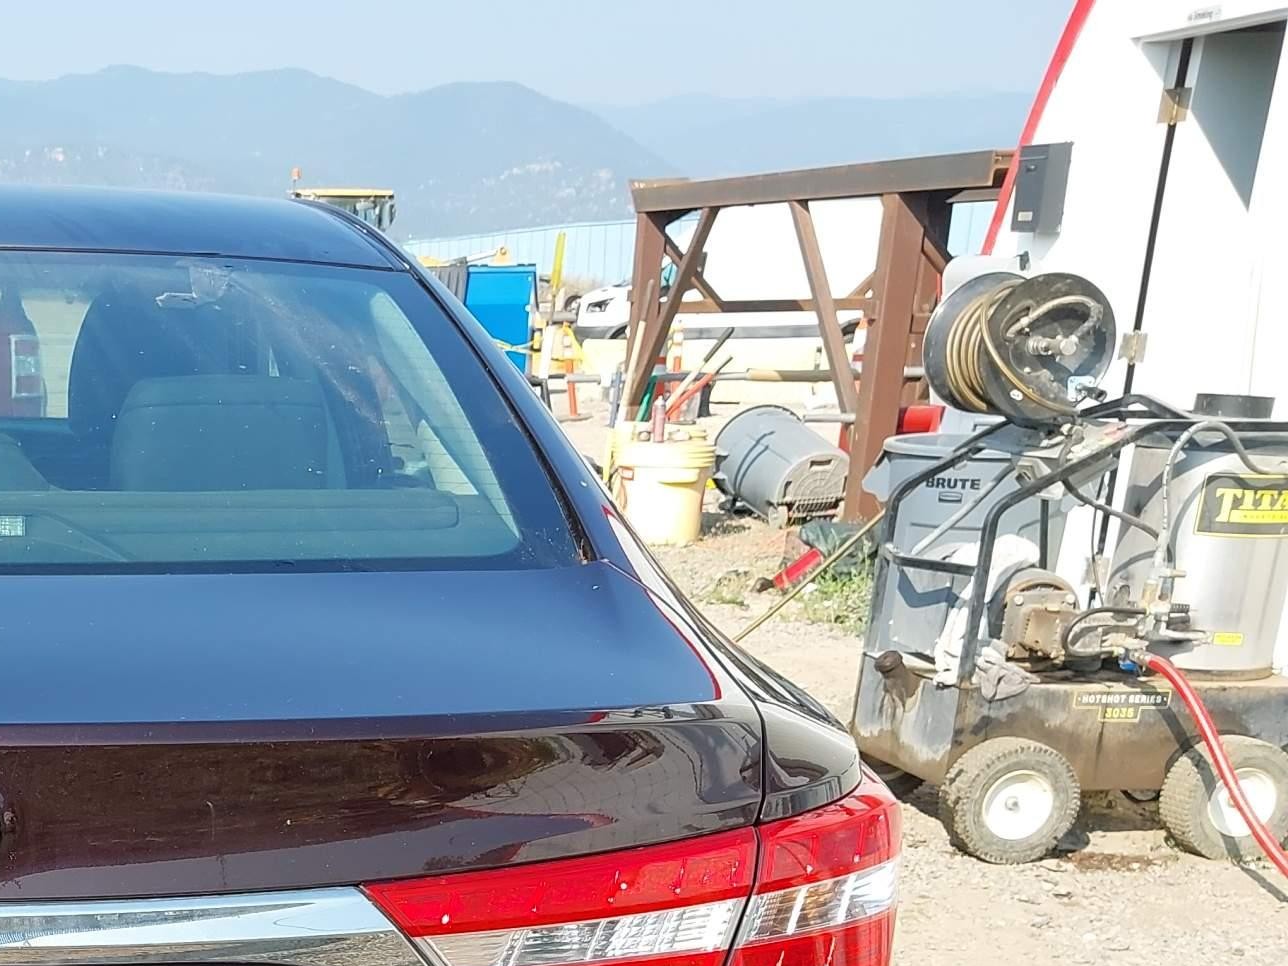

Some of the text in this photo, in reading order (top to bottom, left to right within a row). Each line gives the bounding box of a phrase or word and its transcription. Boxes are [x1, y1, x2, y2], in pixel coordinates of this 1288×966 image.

[925, 477, 981, 490] BRUTE
[1081, 694, 1162, 704] HOTSHOT SERIES
